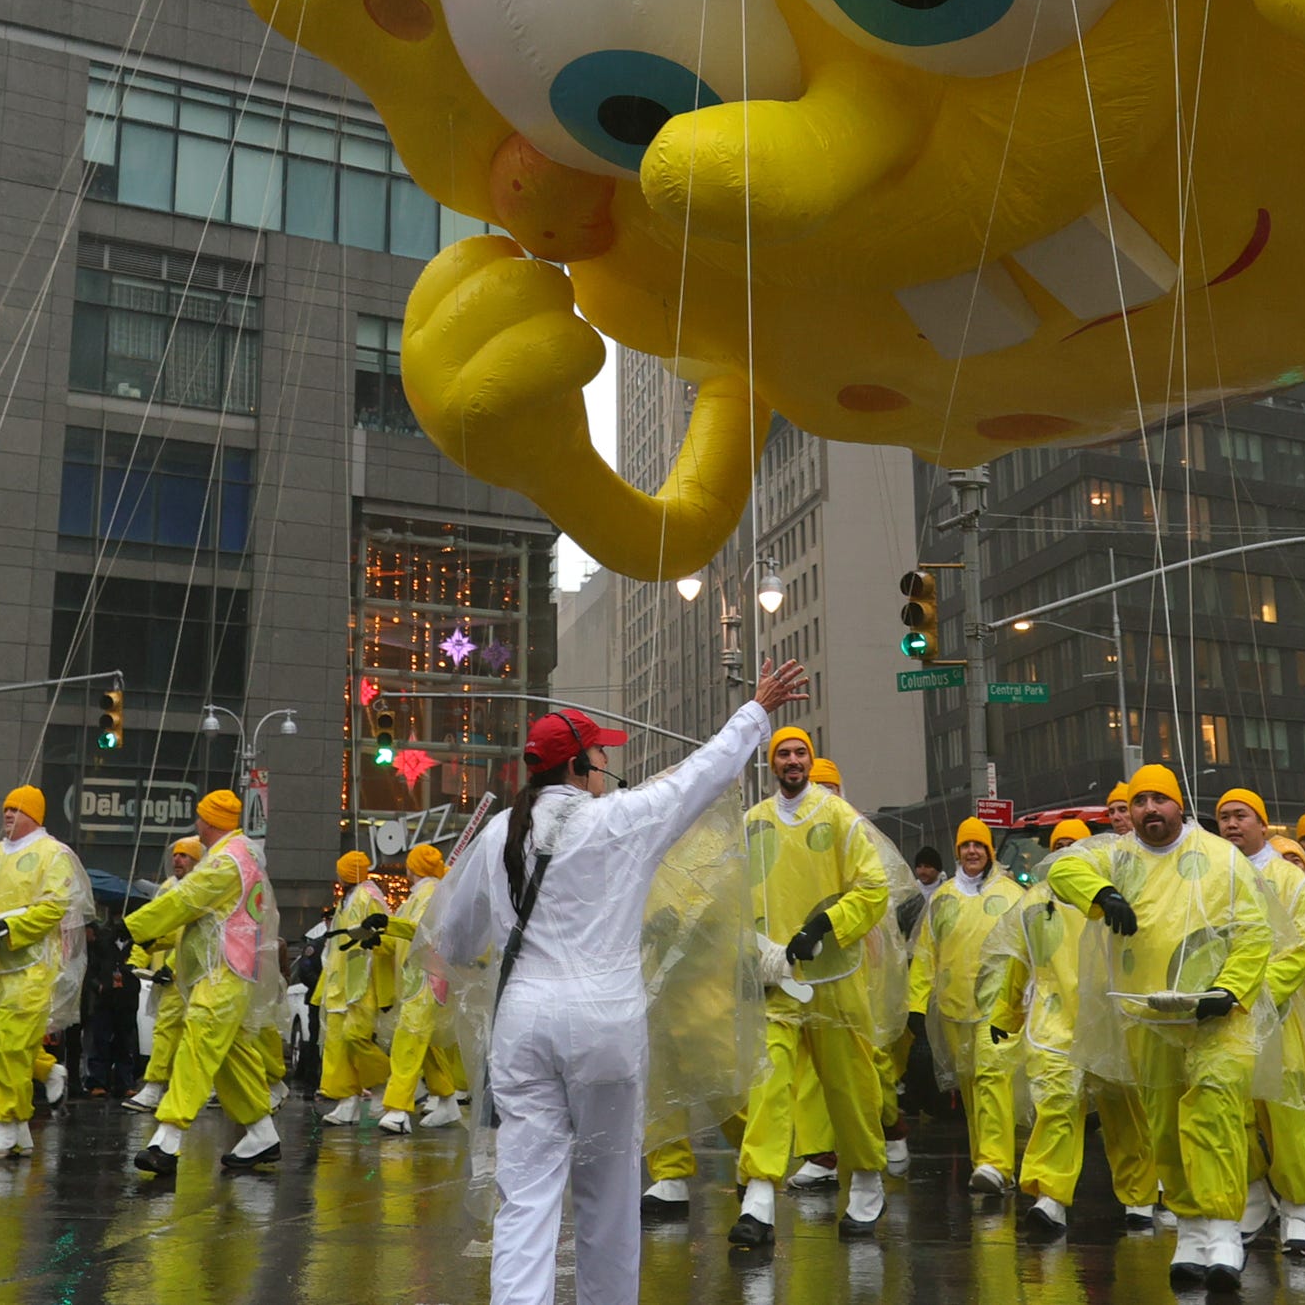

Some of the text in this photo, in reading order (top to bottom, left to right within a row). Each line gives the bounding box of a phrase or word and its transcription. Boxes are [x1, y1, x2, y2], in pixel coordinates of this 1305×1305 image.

[900, 673, 950, 690] Columbus
[990, 685, 1045, 696] Central Park
[453, 827, 474, 858] lincoln
[472, 796, 491, 827] center
